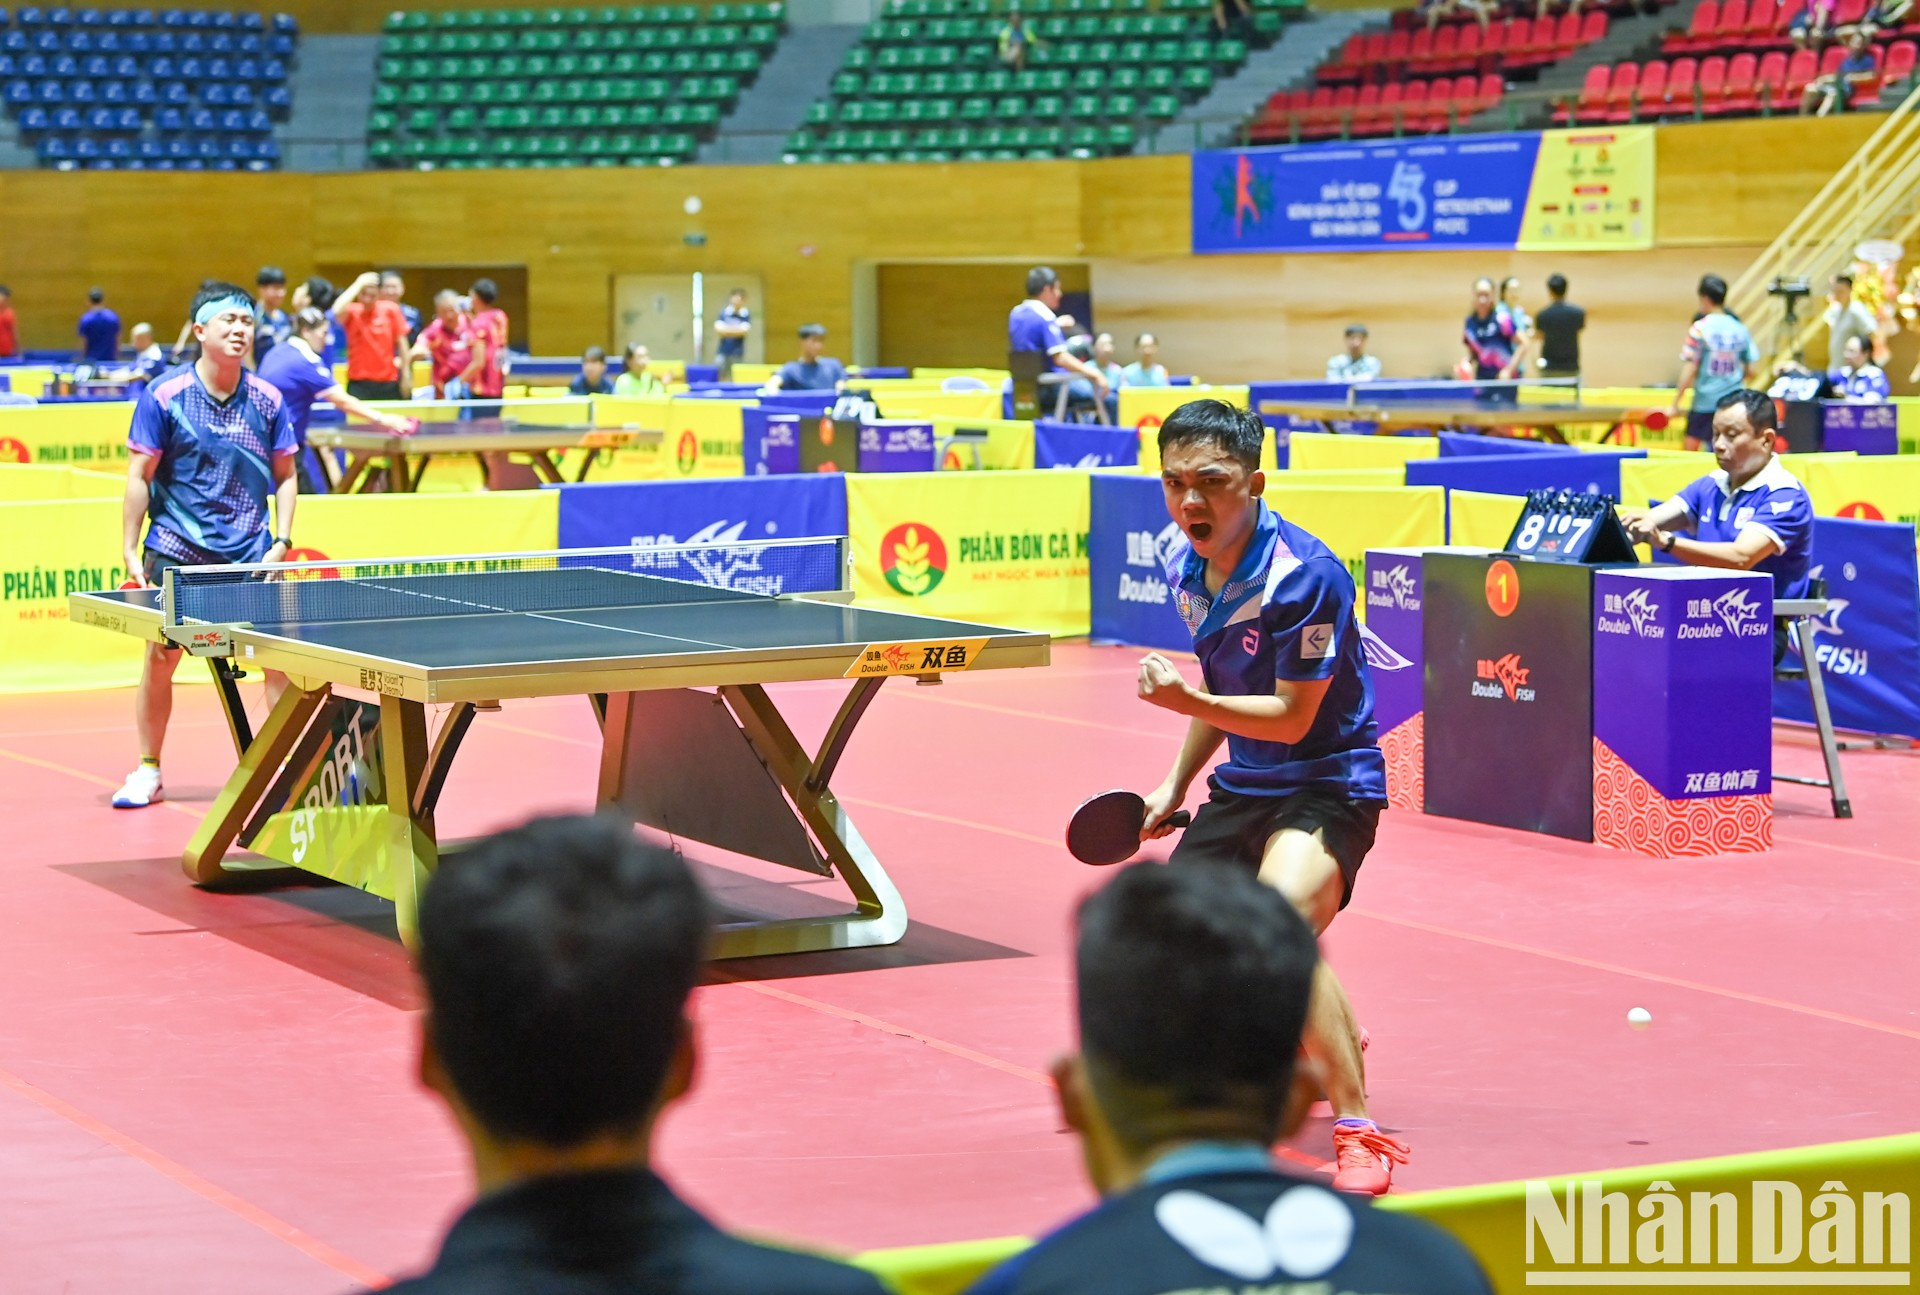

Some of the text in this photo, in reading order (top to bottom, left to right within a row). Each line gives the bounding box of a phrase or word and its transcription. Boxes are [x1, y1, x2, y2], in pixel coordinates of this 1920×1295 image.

[1516, 513, 1593, 554] 8 10 7
[4, 564, 57, 600] PHÂN
[1118, 572, 1169, 604] Double
[1497, 573, 1508, 604] 1
[1597, 616, 1665, 639] Double FISH
[1677, 622, 1768, 640] Double FISH
[861, 663, 915, 673] Double FISH
[920, 645, 967, 669] 双鱼
[1815, 644, 1868, 676] FISH
[1471, 681, 1536, 702] Double FISH
[289, 704, 364, 864] SPORT
